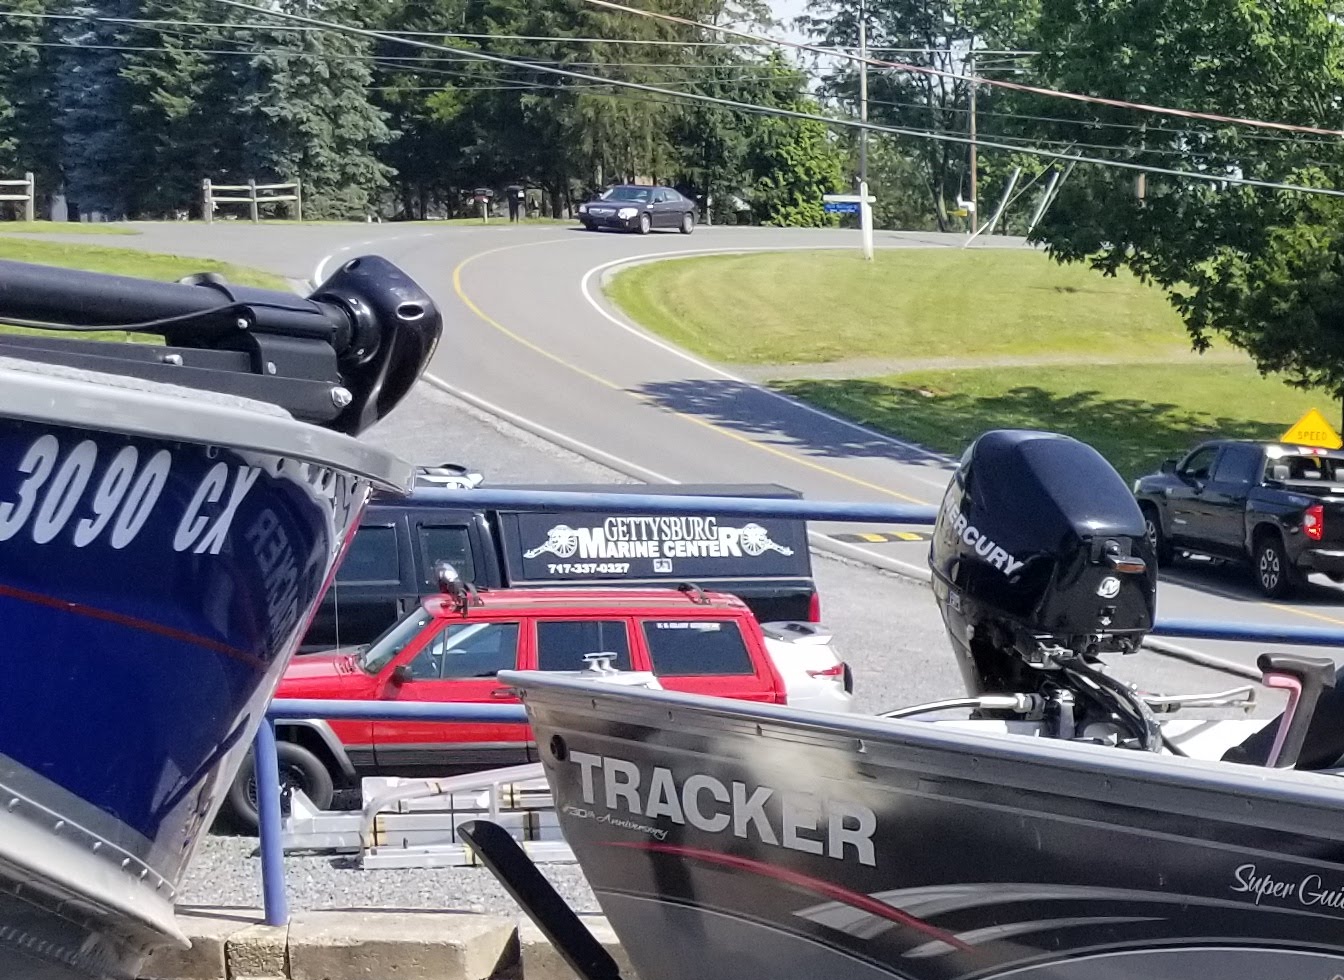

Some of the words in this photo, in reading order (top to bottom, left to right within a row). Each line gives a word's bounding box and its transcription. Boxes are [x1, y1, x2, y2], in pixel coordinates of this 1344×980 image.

[1297, 431, 1328, 441] SPEED
[0, 434, 172, 549] 3090
[173, 462, 262, 555] CX
[577, 527, 660, 559] MARINE
[667, 526, 743, 558] CENTER
[604, 516, 717, 542] GETTYSBURG
[547, 562, 630, 574] 717-337-0327
[569, 750, 876, 866] TRACKER
[1229, 863, 1296, 905] Super
